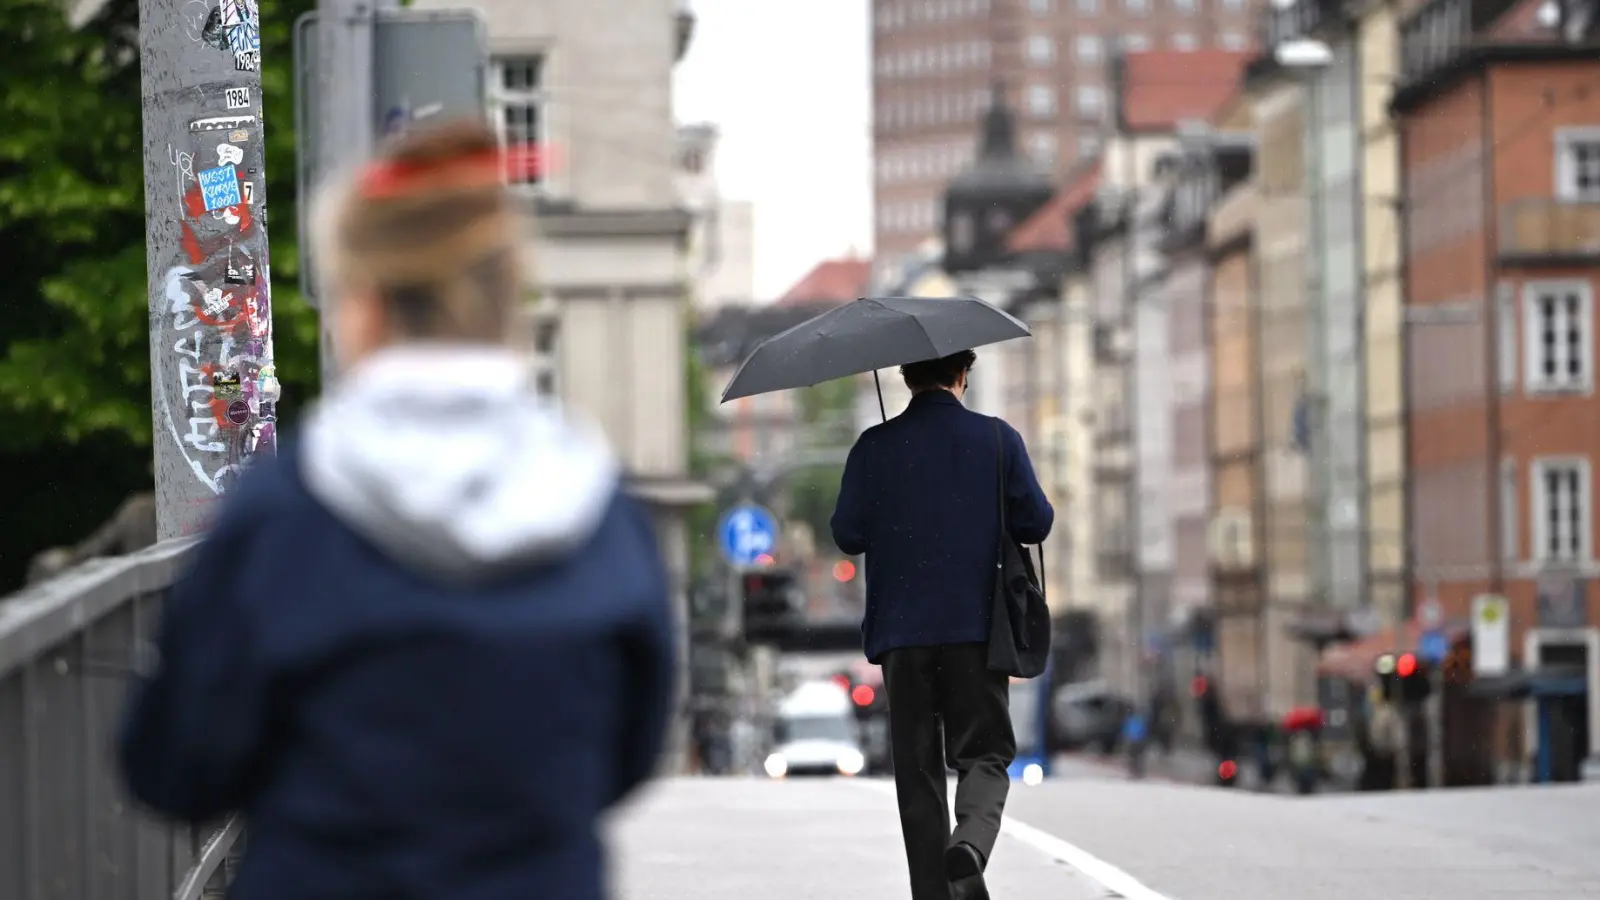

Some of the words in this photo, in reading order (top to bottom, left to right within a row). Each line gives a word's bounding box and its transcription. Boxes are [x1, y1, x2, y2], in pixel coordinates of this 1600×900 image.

[227, 90, 249, 107] 1984
[211, 193, 236, 208] 1860
[245, 185, 252, 201] 7
